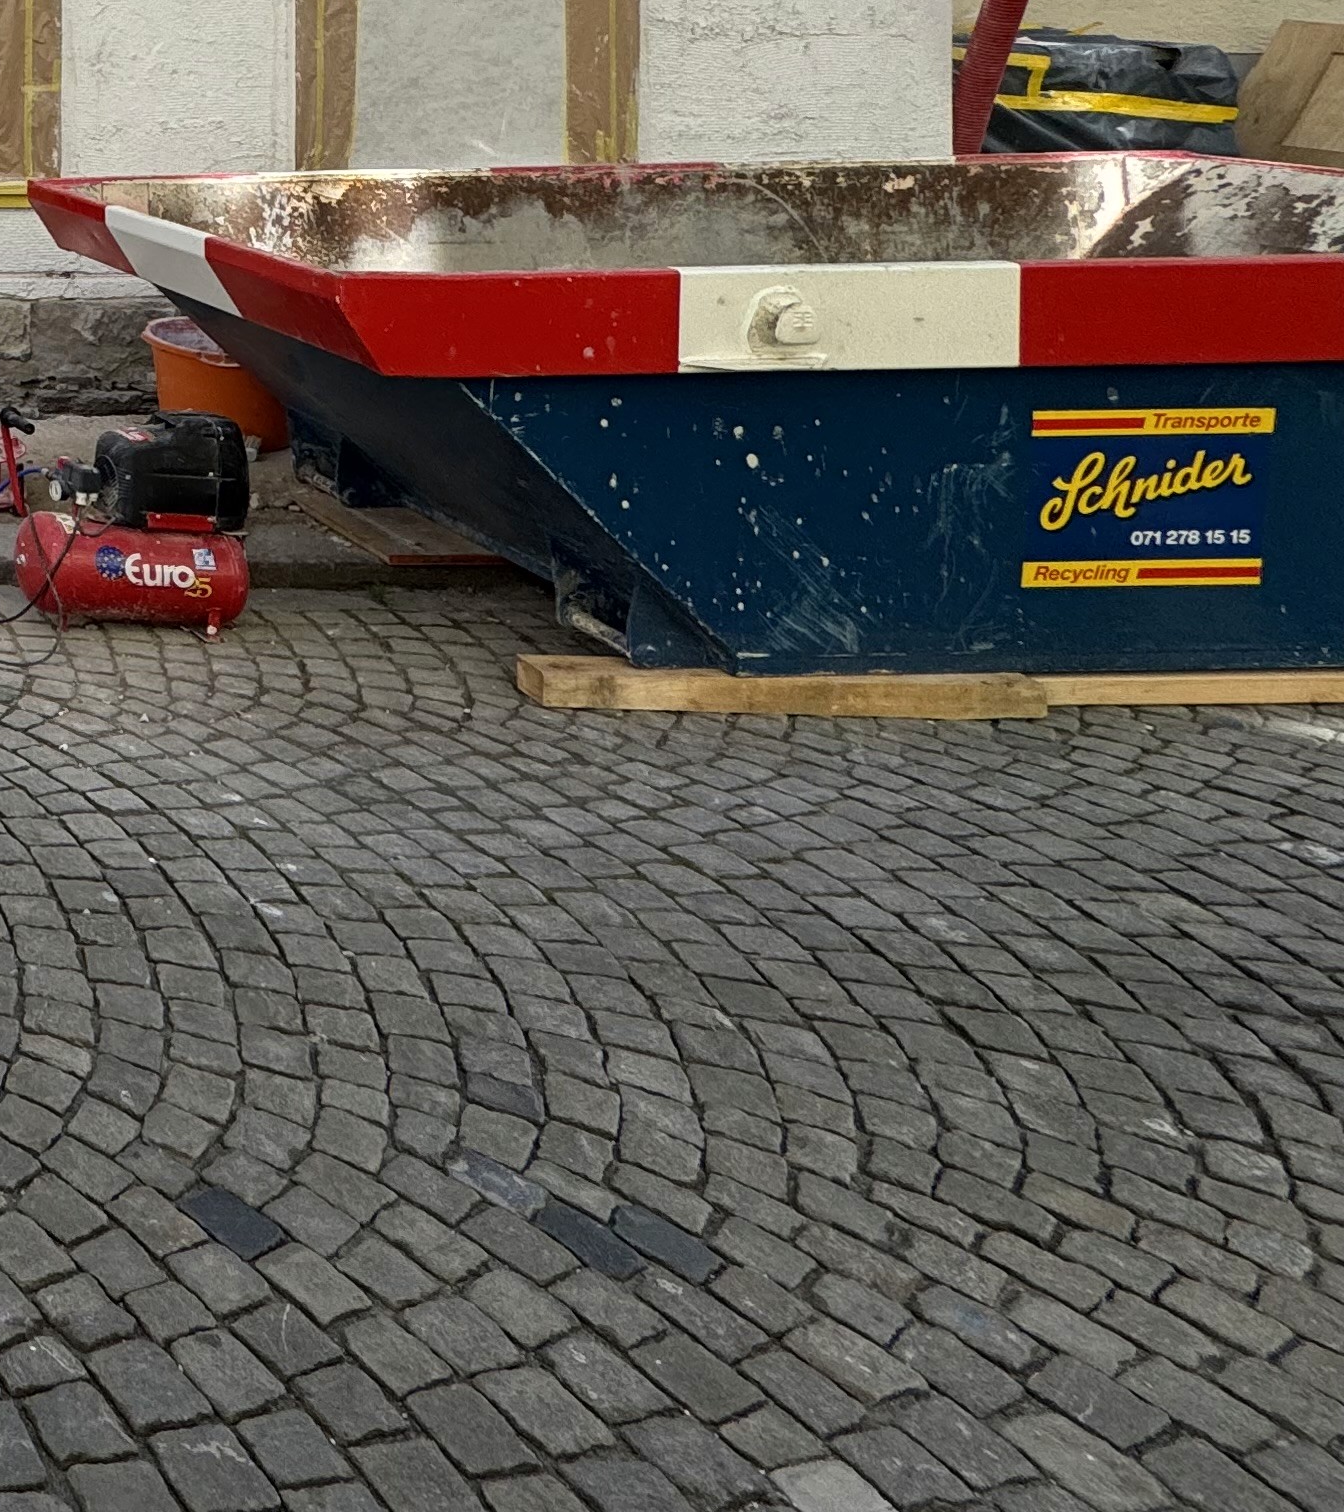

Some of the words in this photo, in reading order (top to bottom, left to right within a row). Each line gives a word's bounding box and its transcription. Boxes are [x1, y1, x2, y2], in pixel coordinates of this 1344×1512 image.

[1152, 413, 1261, 431] Transporte
[1039, 449, 1252, 531] Schnider
[1130, 531, 1162, 546] 071
[1165, 530, 1200, 545] 278
[1205, 529, 1226, 544] 15
[1230, 529, 1251, 544] 15
[124, 552, 196, 589] Euro
[1033, 565, 1130, 583] Recycling
